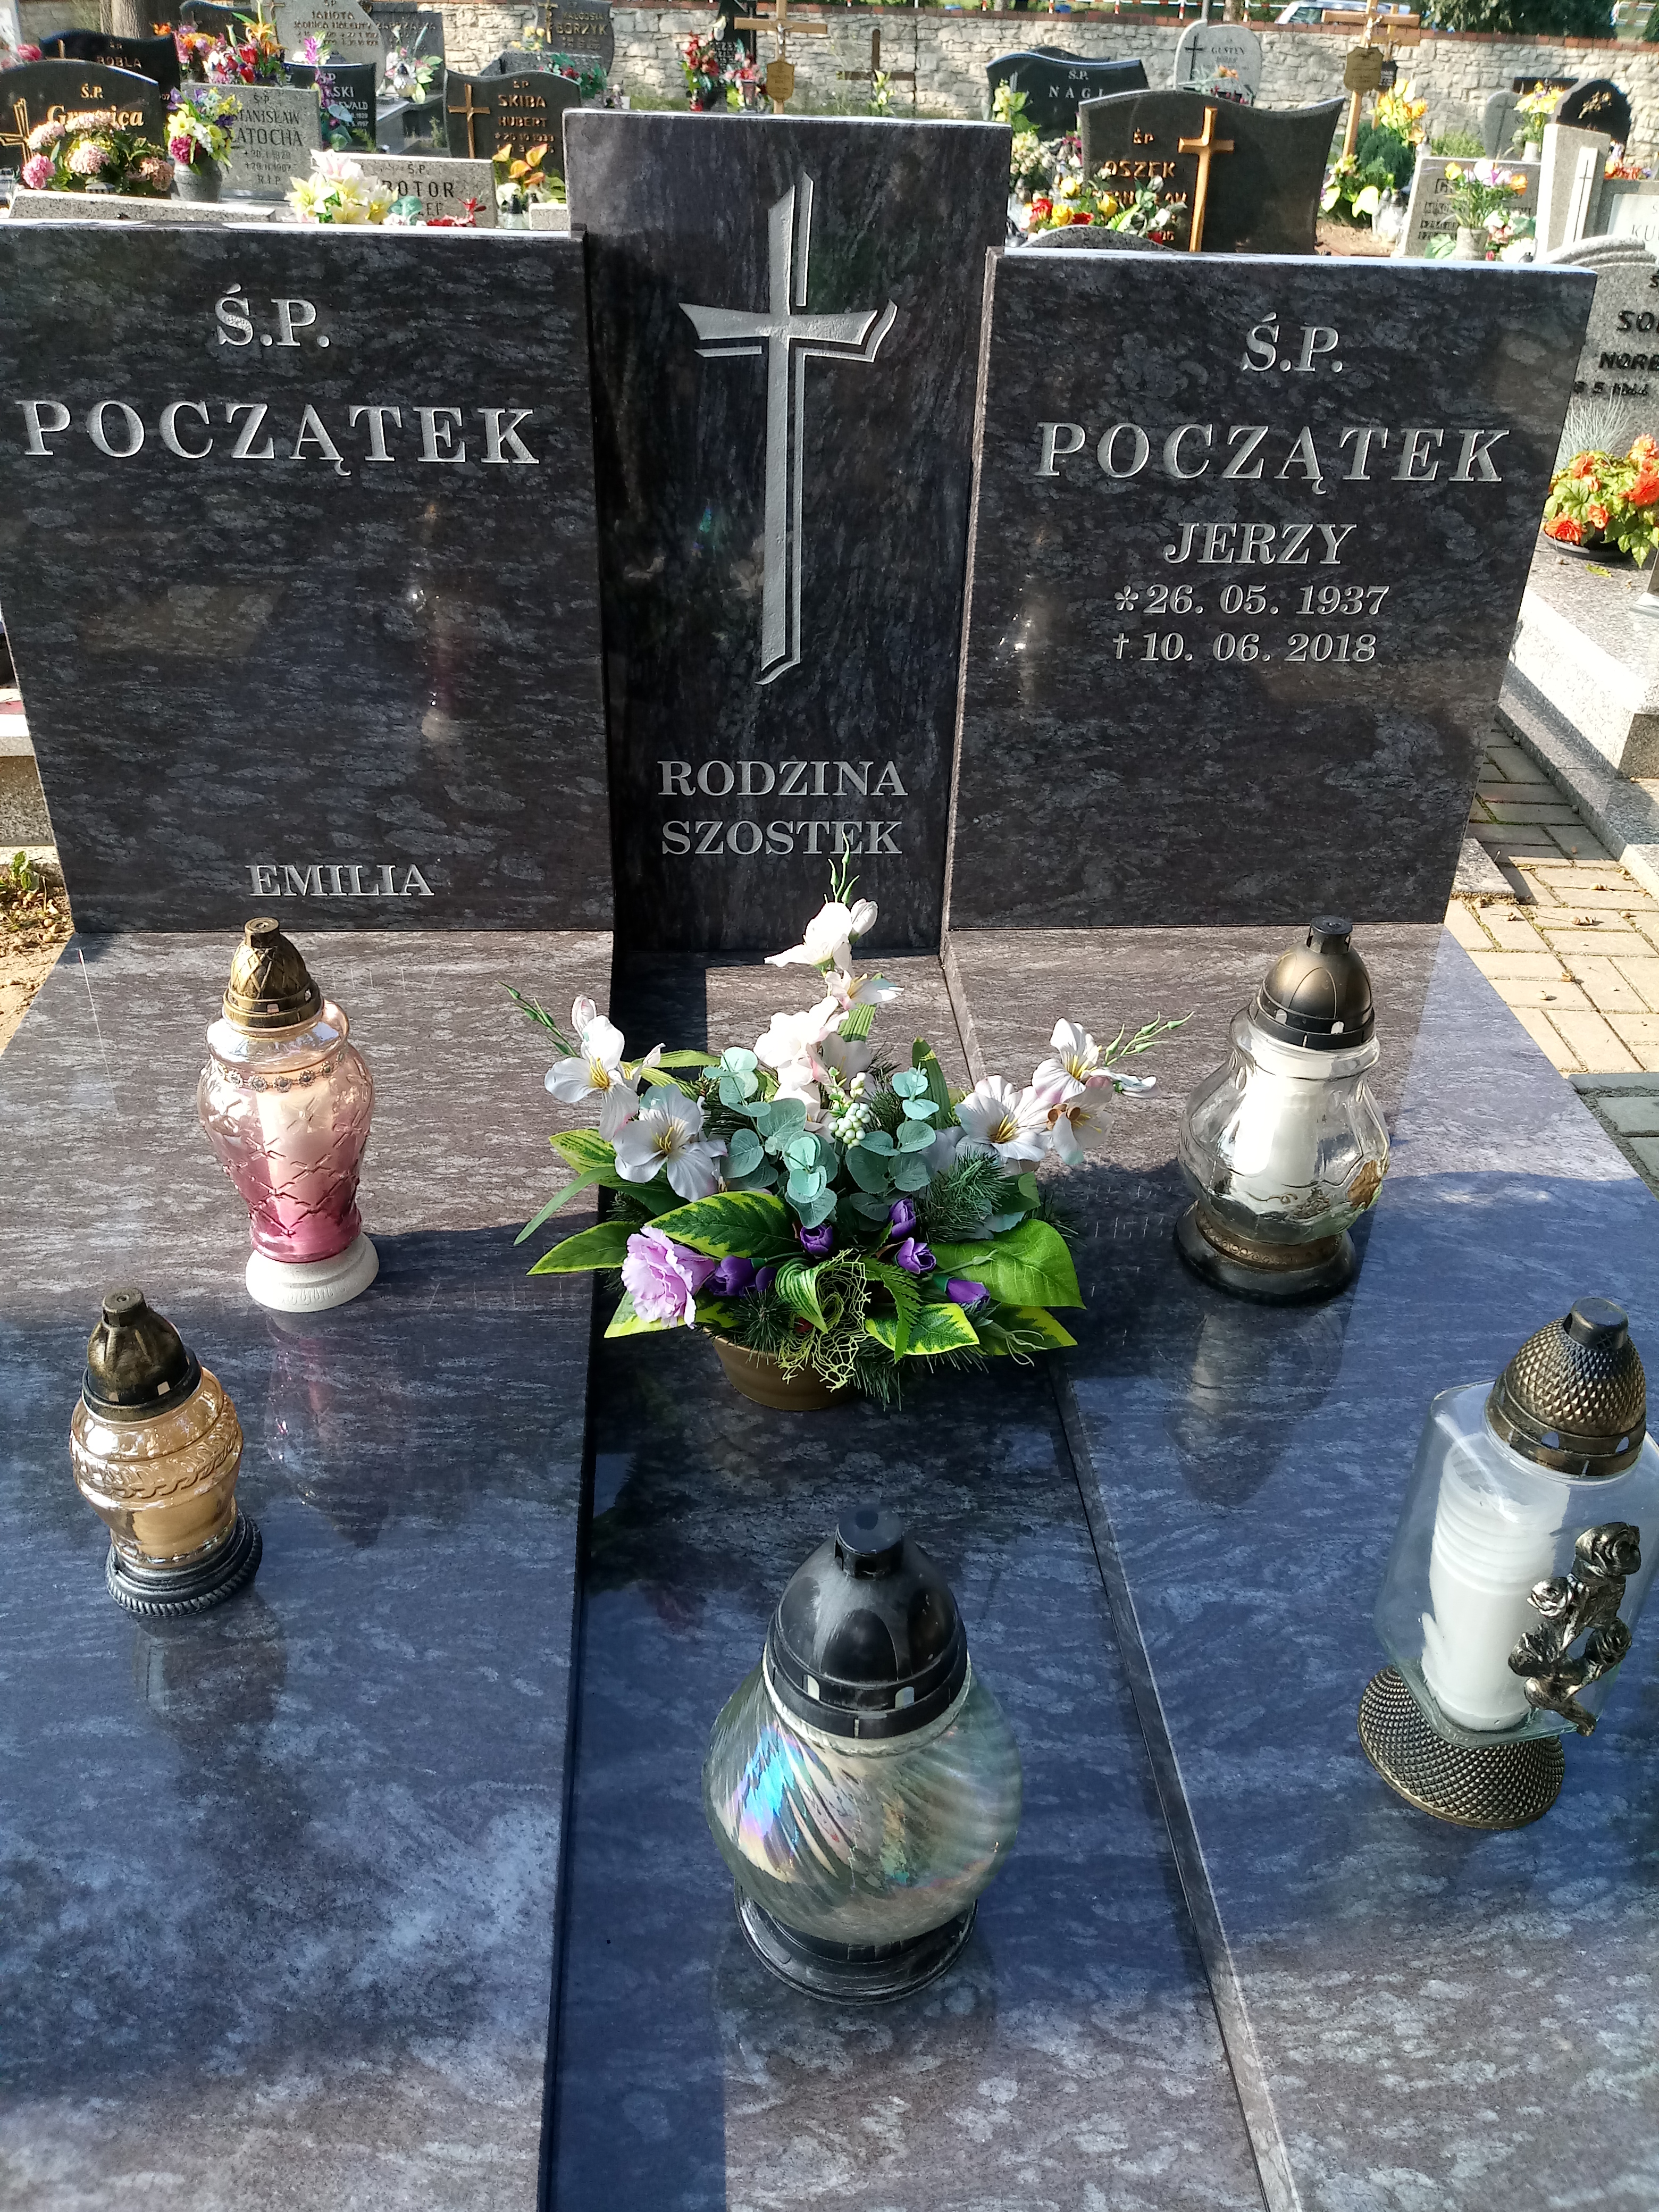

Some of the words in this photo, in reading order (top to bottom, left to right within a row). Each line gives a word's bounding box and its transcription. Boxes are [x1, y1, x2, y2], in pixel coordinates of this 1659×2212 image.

[81, 82, 104, 98] Ś.P.
[498, 94, 547, 108] SKIBA
[498, 116, 548, 128] HUBERT
[215, 283, 330, 348] Ś.P.
[1241, 312, 1344, 373] Ś.P.
[15, 399, 540, 476] POCZĄTEK
[1034, 422, 1510, 495] POCZĄTEK
[1163, 521, 1357, 565] JERZY
[1219, 584, 1279, 615] 05.
[1295, 584, 1390, 615] 1937
[1212, 632, 1271, 663] 06.
[1284, 632, 1377, 663] 2018
[657, 760, 909, 797] RODZINA
[661, 820, 903, 855] SZOSTEK
[245, 862, 435, 897] EMILIA
